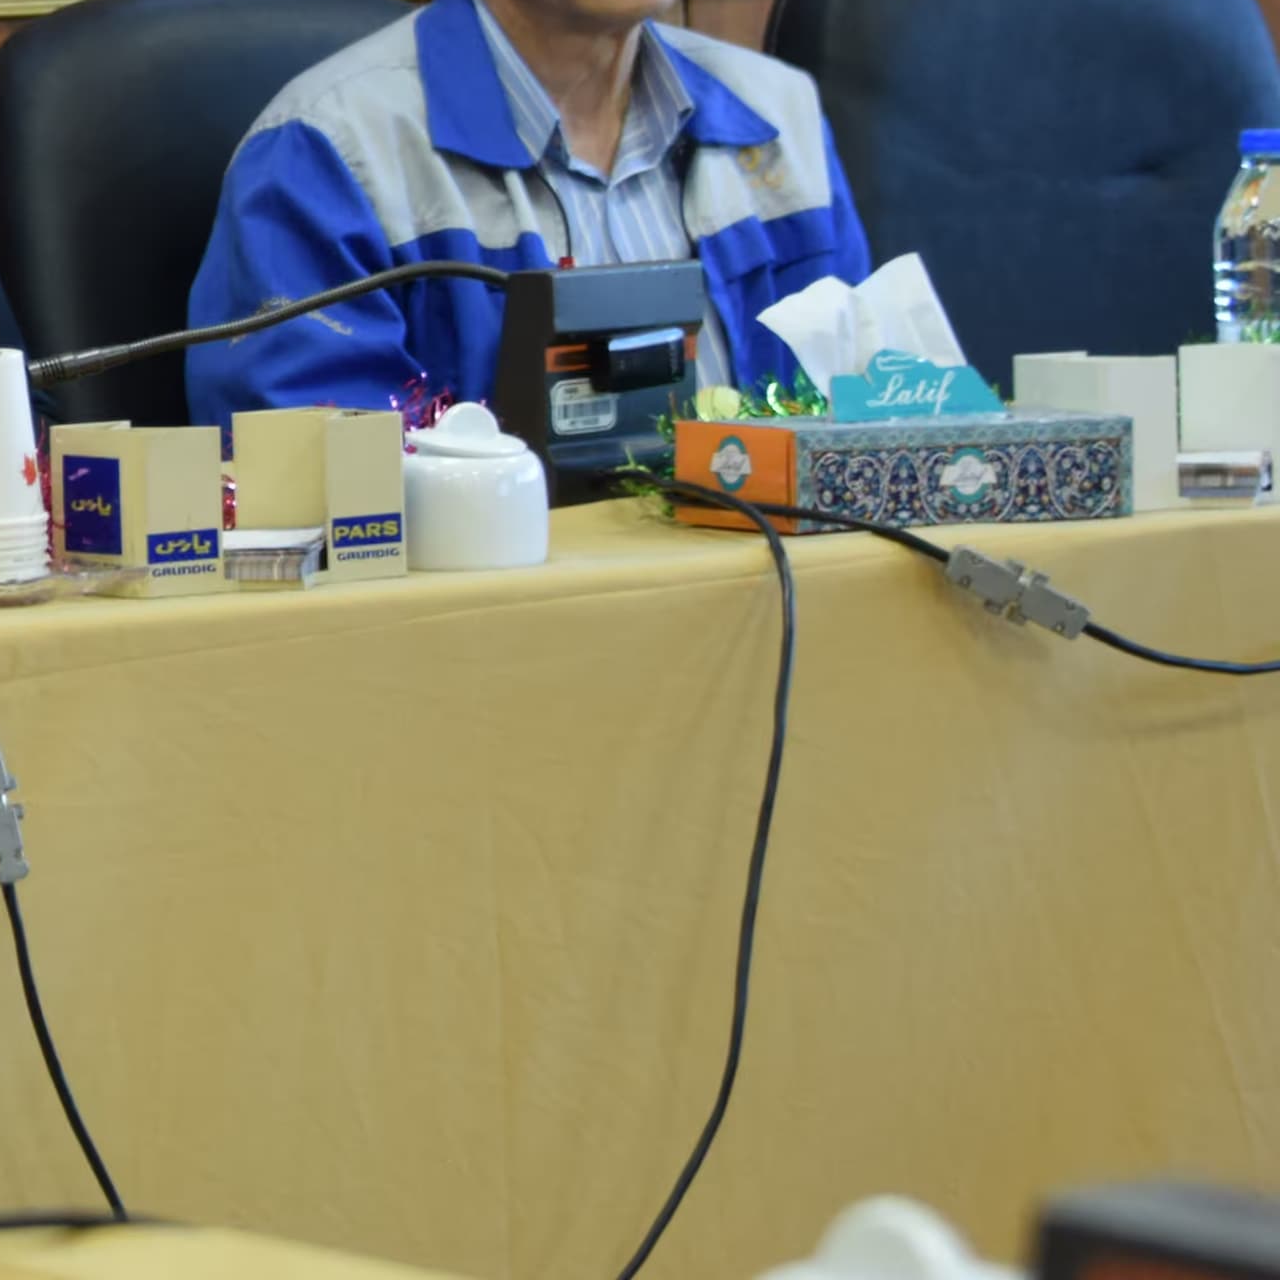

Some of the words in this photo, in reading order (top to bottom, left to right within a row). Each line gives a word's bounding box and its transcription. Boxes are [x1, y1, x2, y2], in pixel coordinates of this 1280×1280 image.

[866, 371, 955, 415] Latif
[334, 520, 399, 542] PARS
[337, 547, 400, 562] GRUNDIG
[152, 564, 217, 578] GRUNDIG
